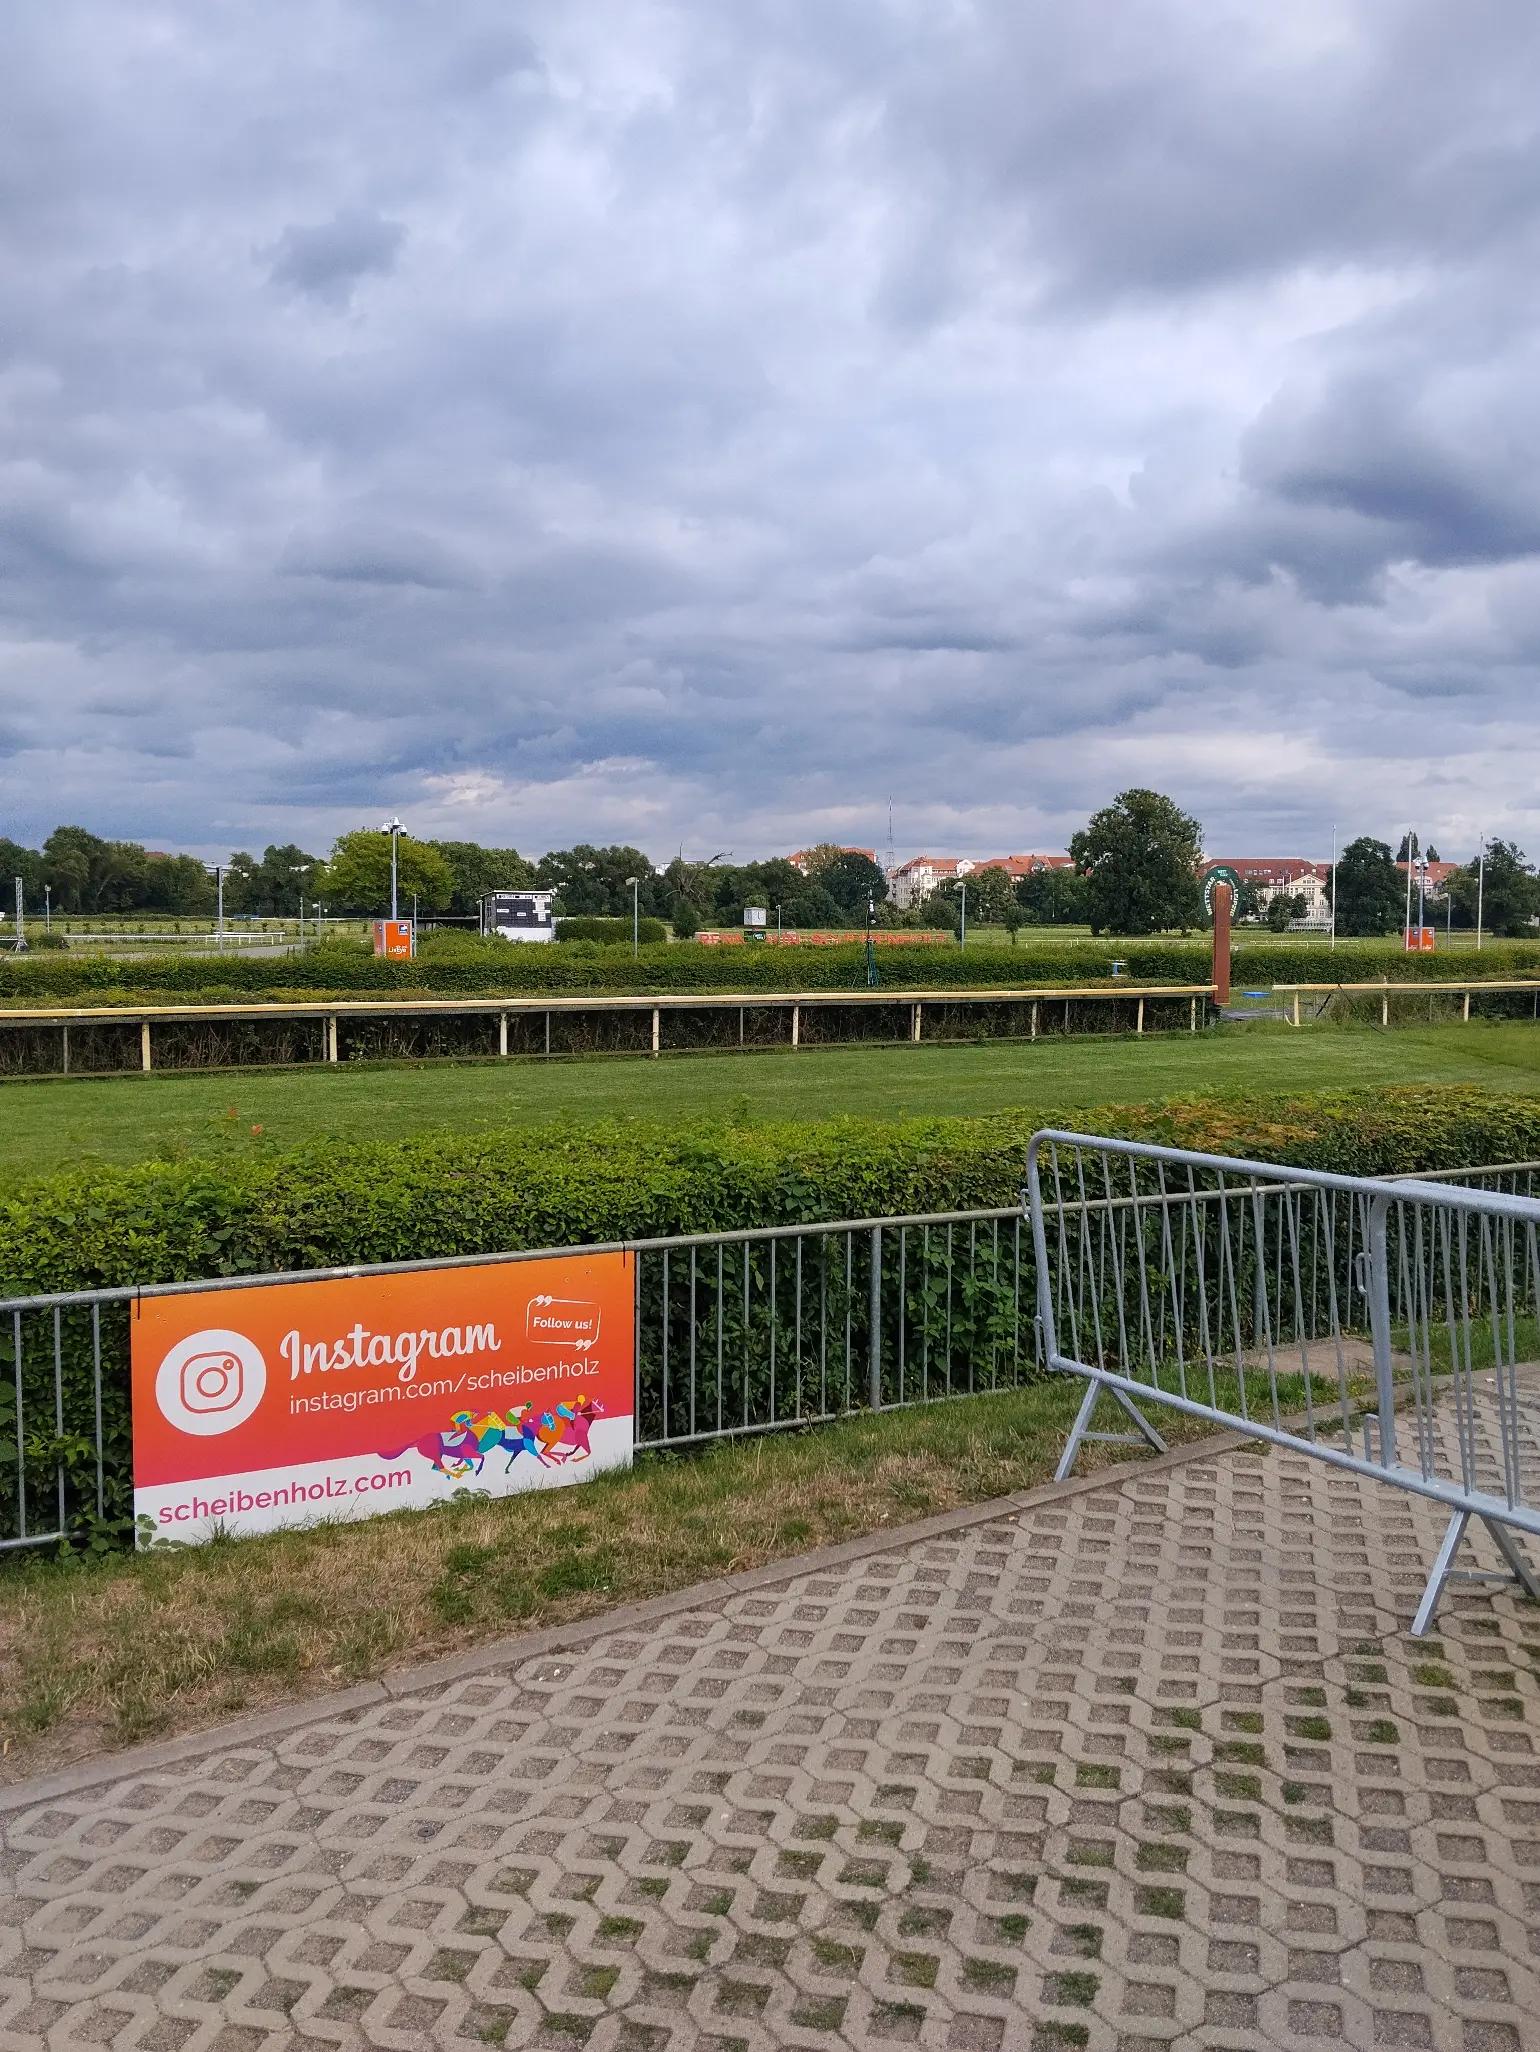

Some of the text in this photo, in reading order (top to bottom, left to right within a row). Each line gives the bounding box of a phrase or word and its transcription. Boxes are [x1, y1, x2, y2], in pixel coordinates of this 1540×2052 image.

[533, 1316, 593, 1330] Follow us!
[279, 1323, 502, 1382] Instagram
[290, 1357, 600, 1415] instagram.com/scheibenholz
[158, 1468, 412, 1524] scheibenholz.com
